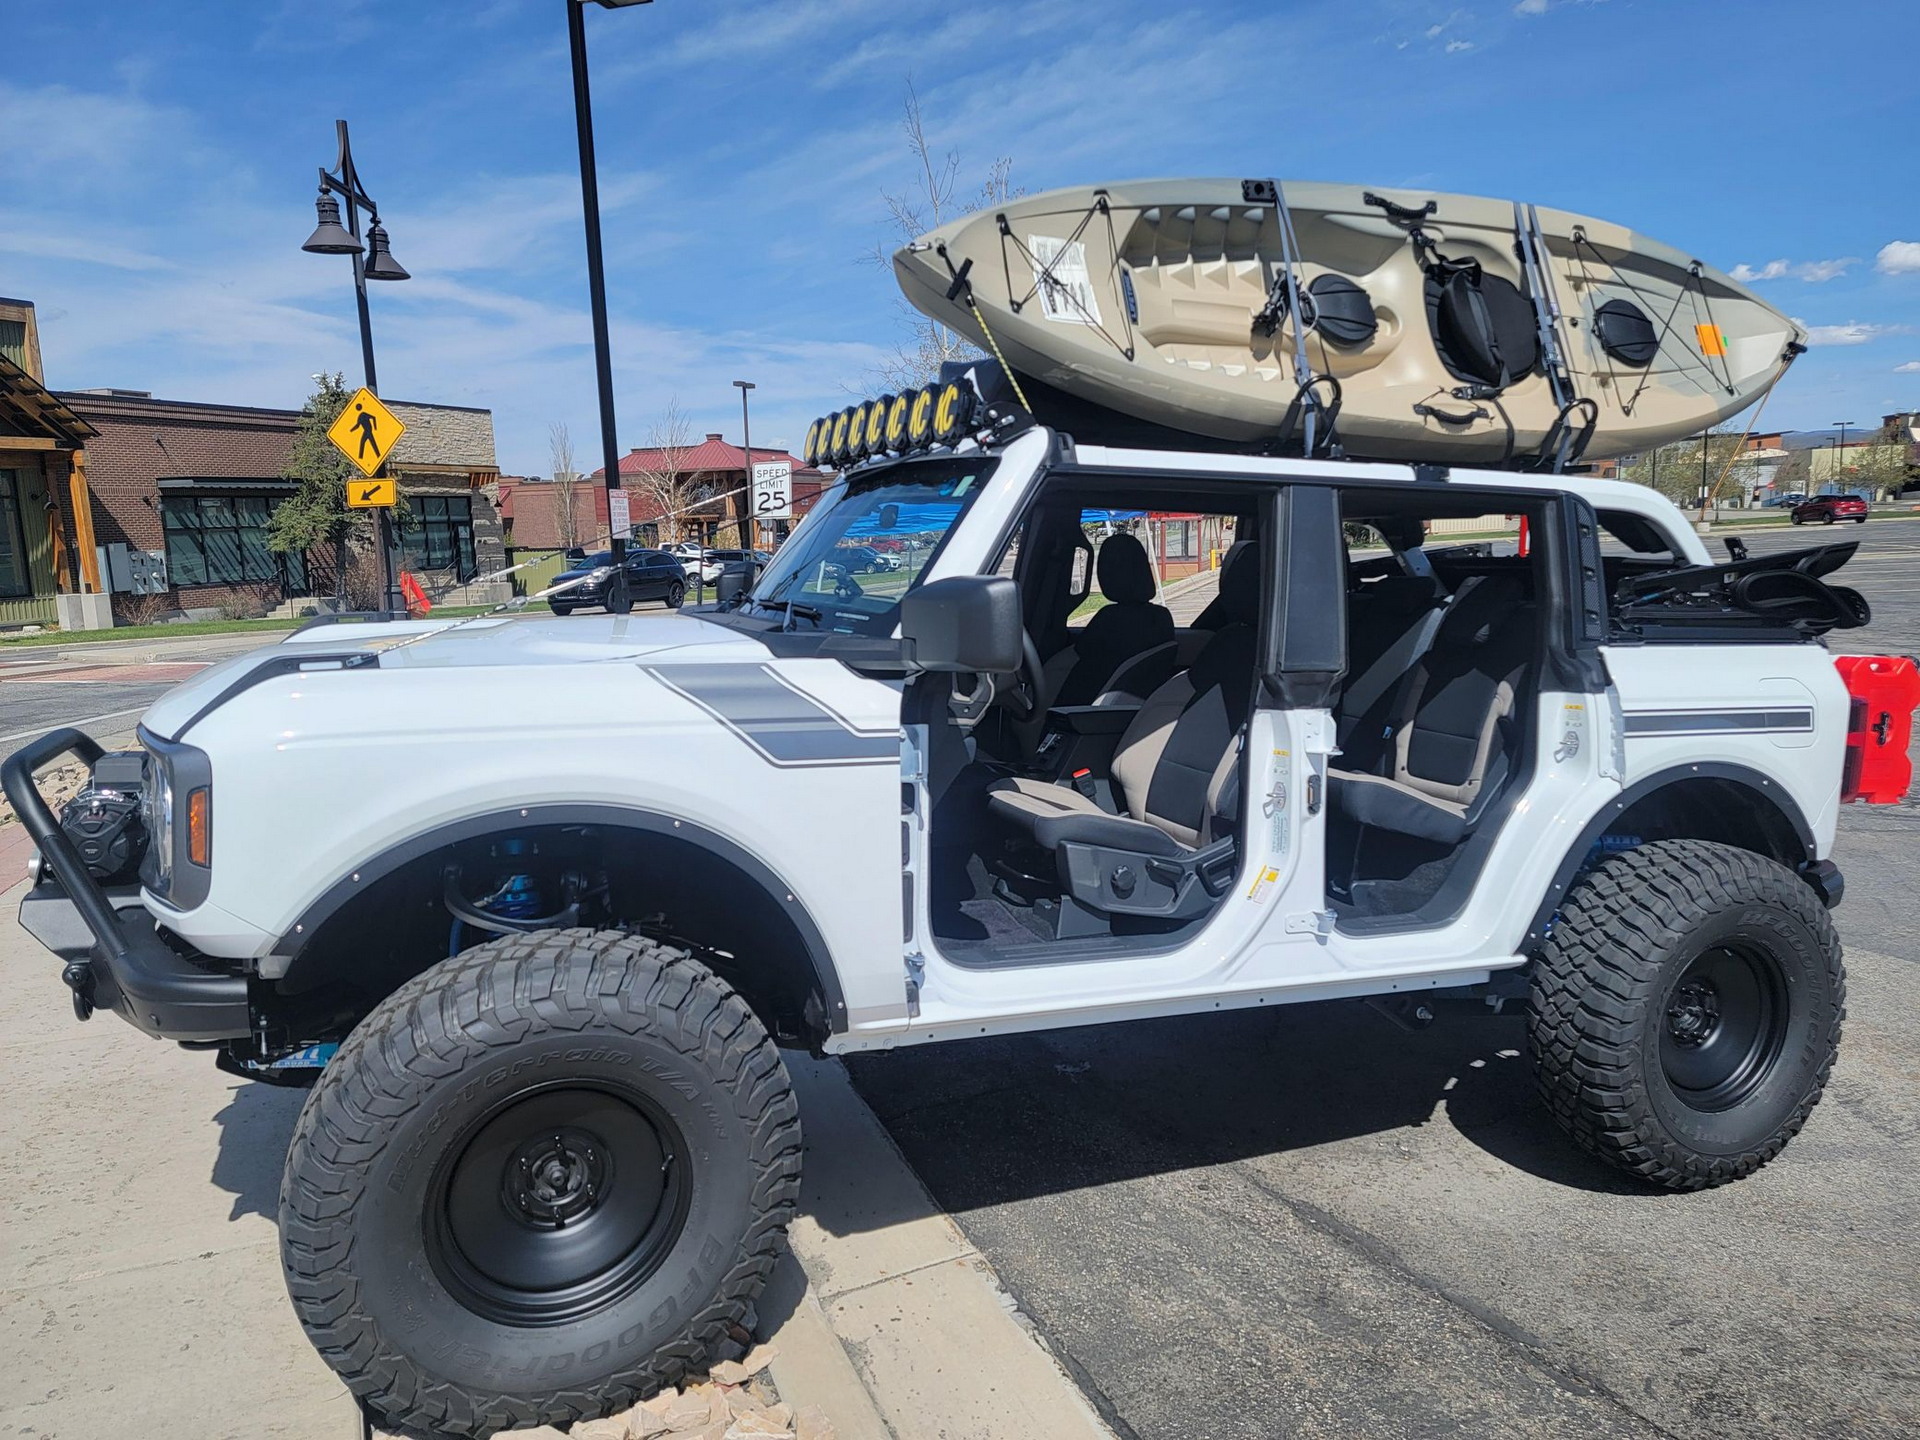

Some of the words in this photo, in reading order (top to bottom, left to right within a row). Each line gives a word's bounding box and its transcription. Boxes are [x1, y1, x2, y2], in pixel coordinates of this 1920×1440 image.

[848, 407, 866, 448] KC
[866, 401, 885, 445] KC
[886, 396, 907, 441] KC
[909, 390, 932, 438] KC
[934, 384, 959, 435] KC
[831, 414, 848, 452] KC
[757, 468, 788, 478] SPEED
[760, 480, 784, 489] LIMIT
[758, 491, 785, 511] 25
[641, 1055, 701, 1101] T/A
